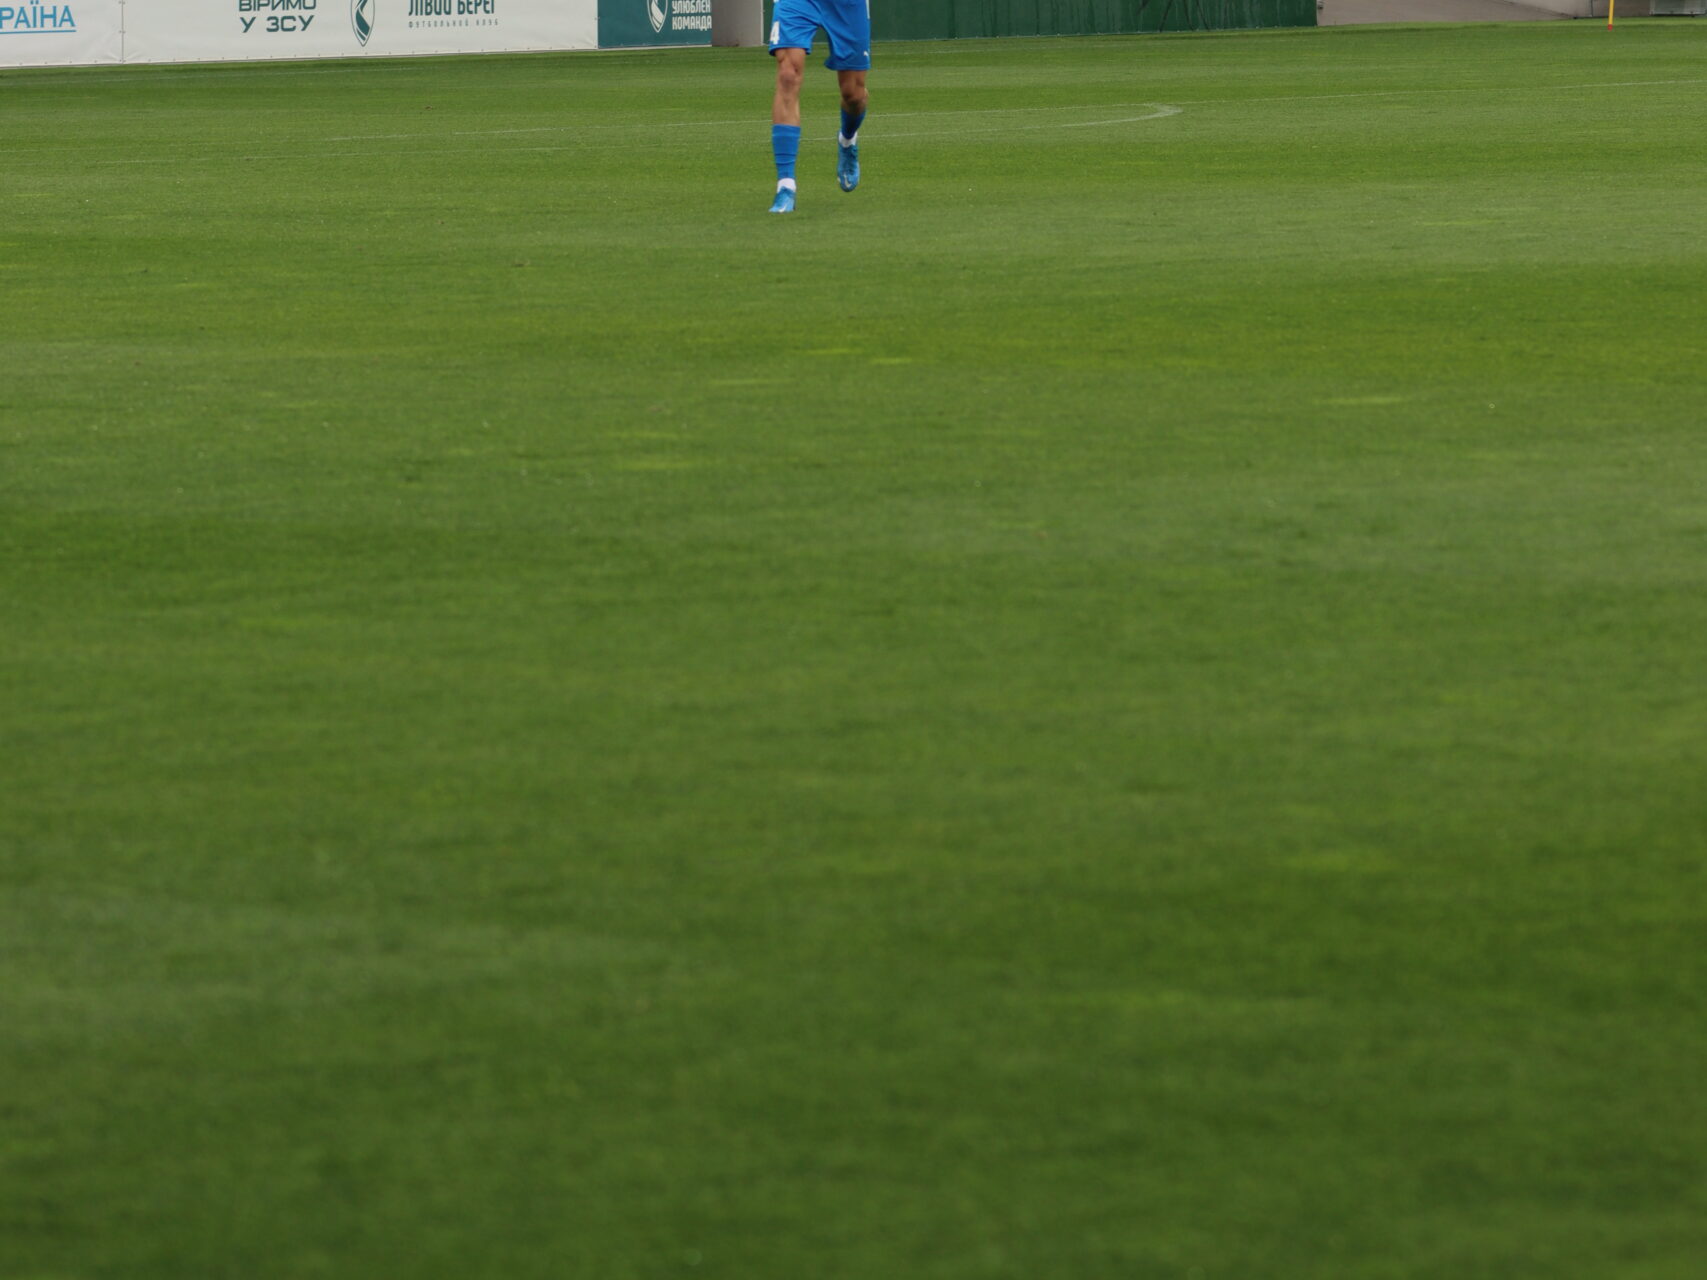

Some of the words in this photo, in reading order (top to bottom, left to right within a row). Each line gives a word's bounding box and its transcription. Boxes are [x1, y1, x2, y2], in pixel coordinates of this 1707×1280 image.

[0, 0, 76, 29] РАЇНА
[672, 15, 712, 31] КОМАНДА
[240, 16, 257, 33] У
[266, 15, 315, 32] ЗСУ
